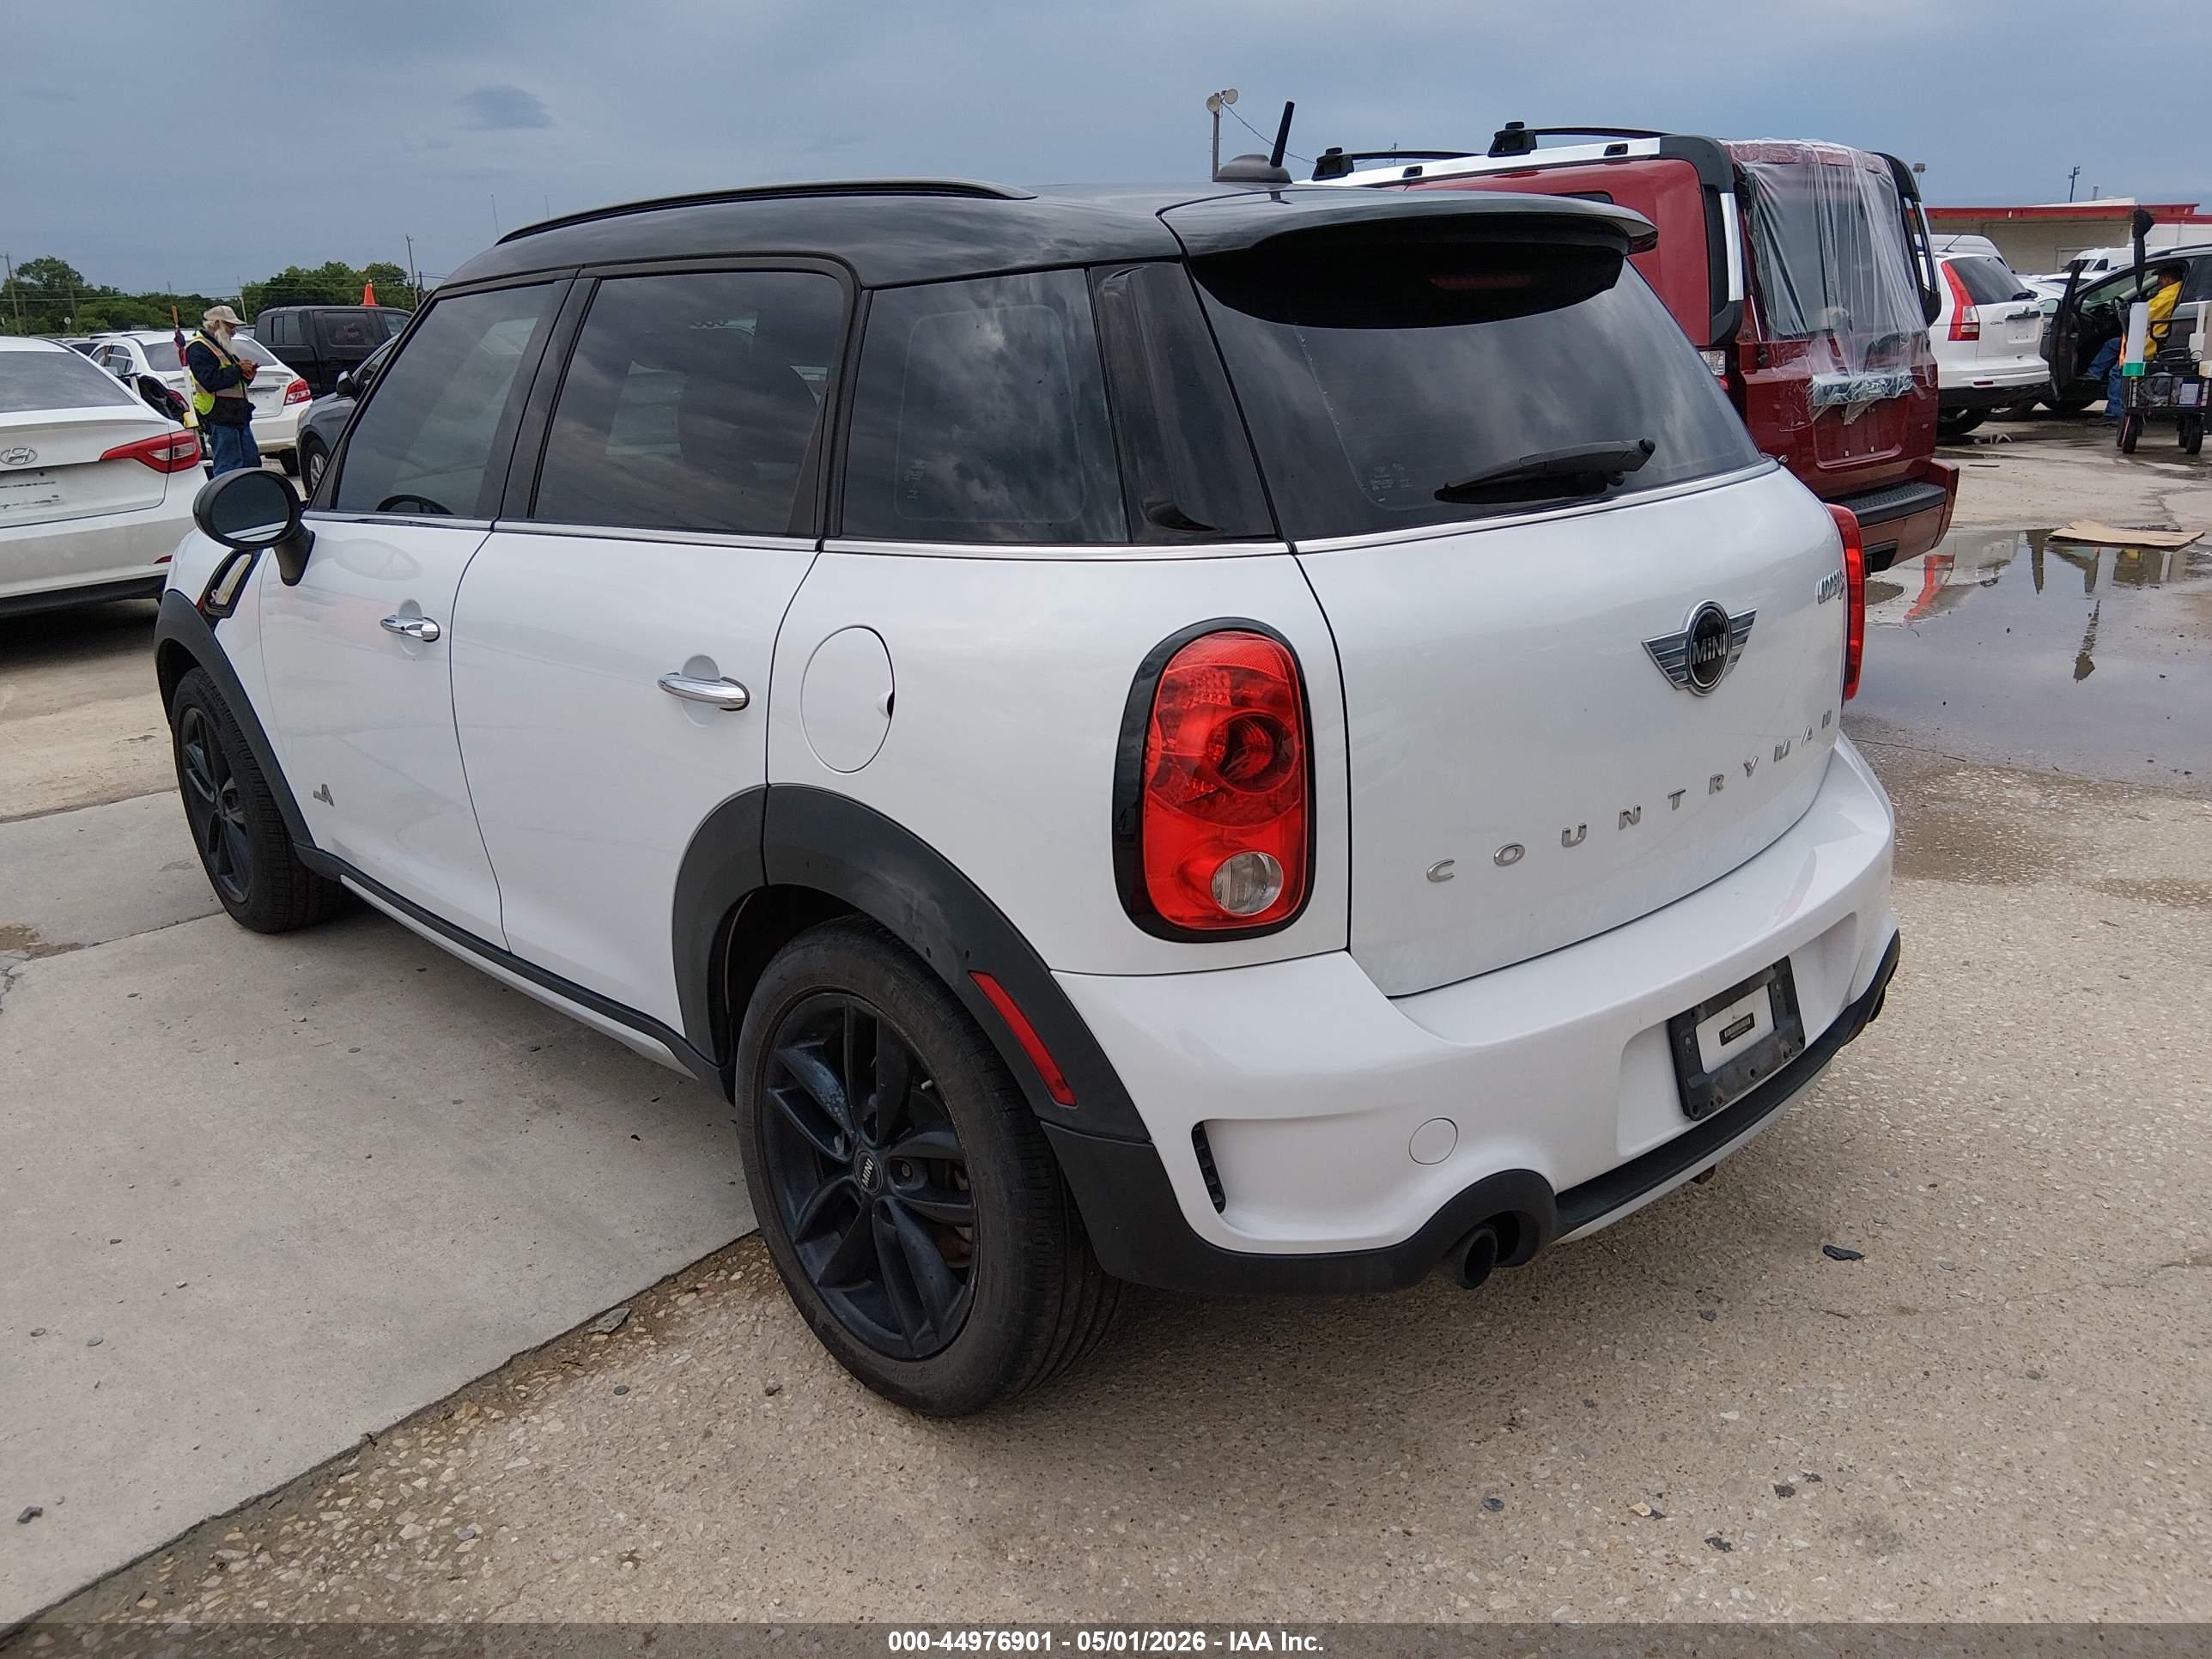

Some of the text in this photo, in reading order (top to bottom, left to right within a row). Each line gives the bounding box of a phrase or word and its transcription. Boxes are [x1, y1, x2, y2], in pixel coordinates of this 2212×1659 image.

[1692, 632, 1726, 665] MINI
[1425, 709, 1832, 883] COUNTRYMAN
[861, 1157, 874, 1188] MINI
